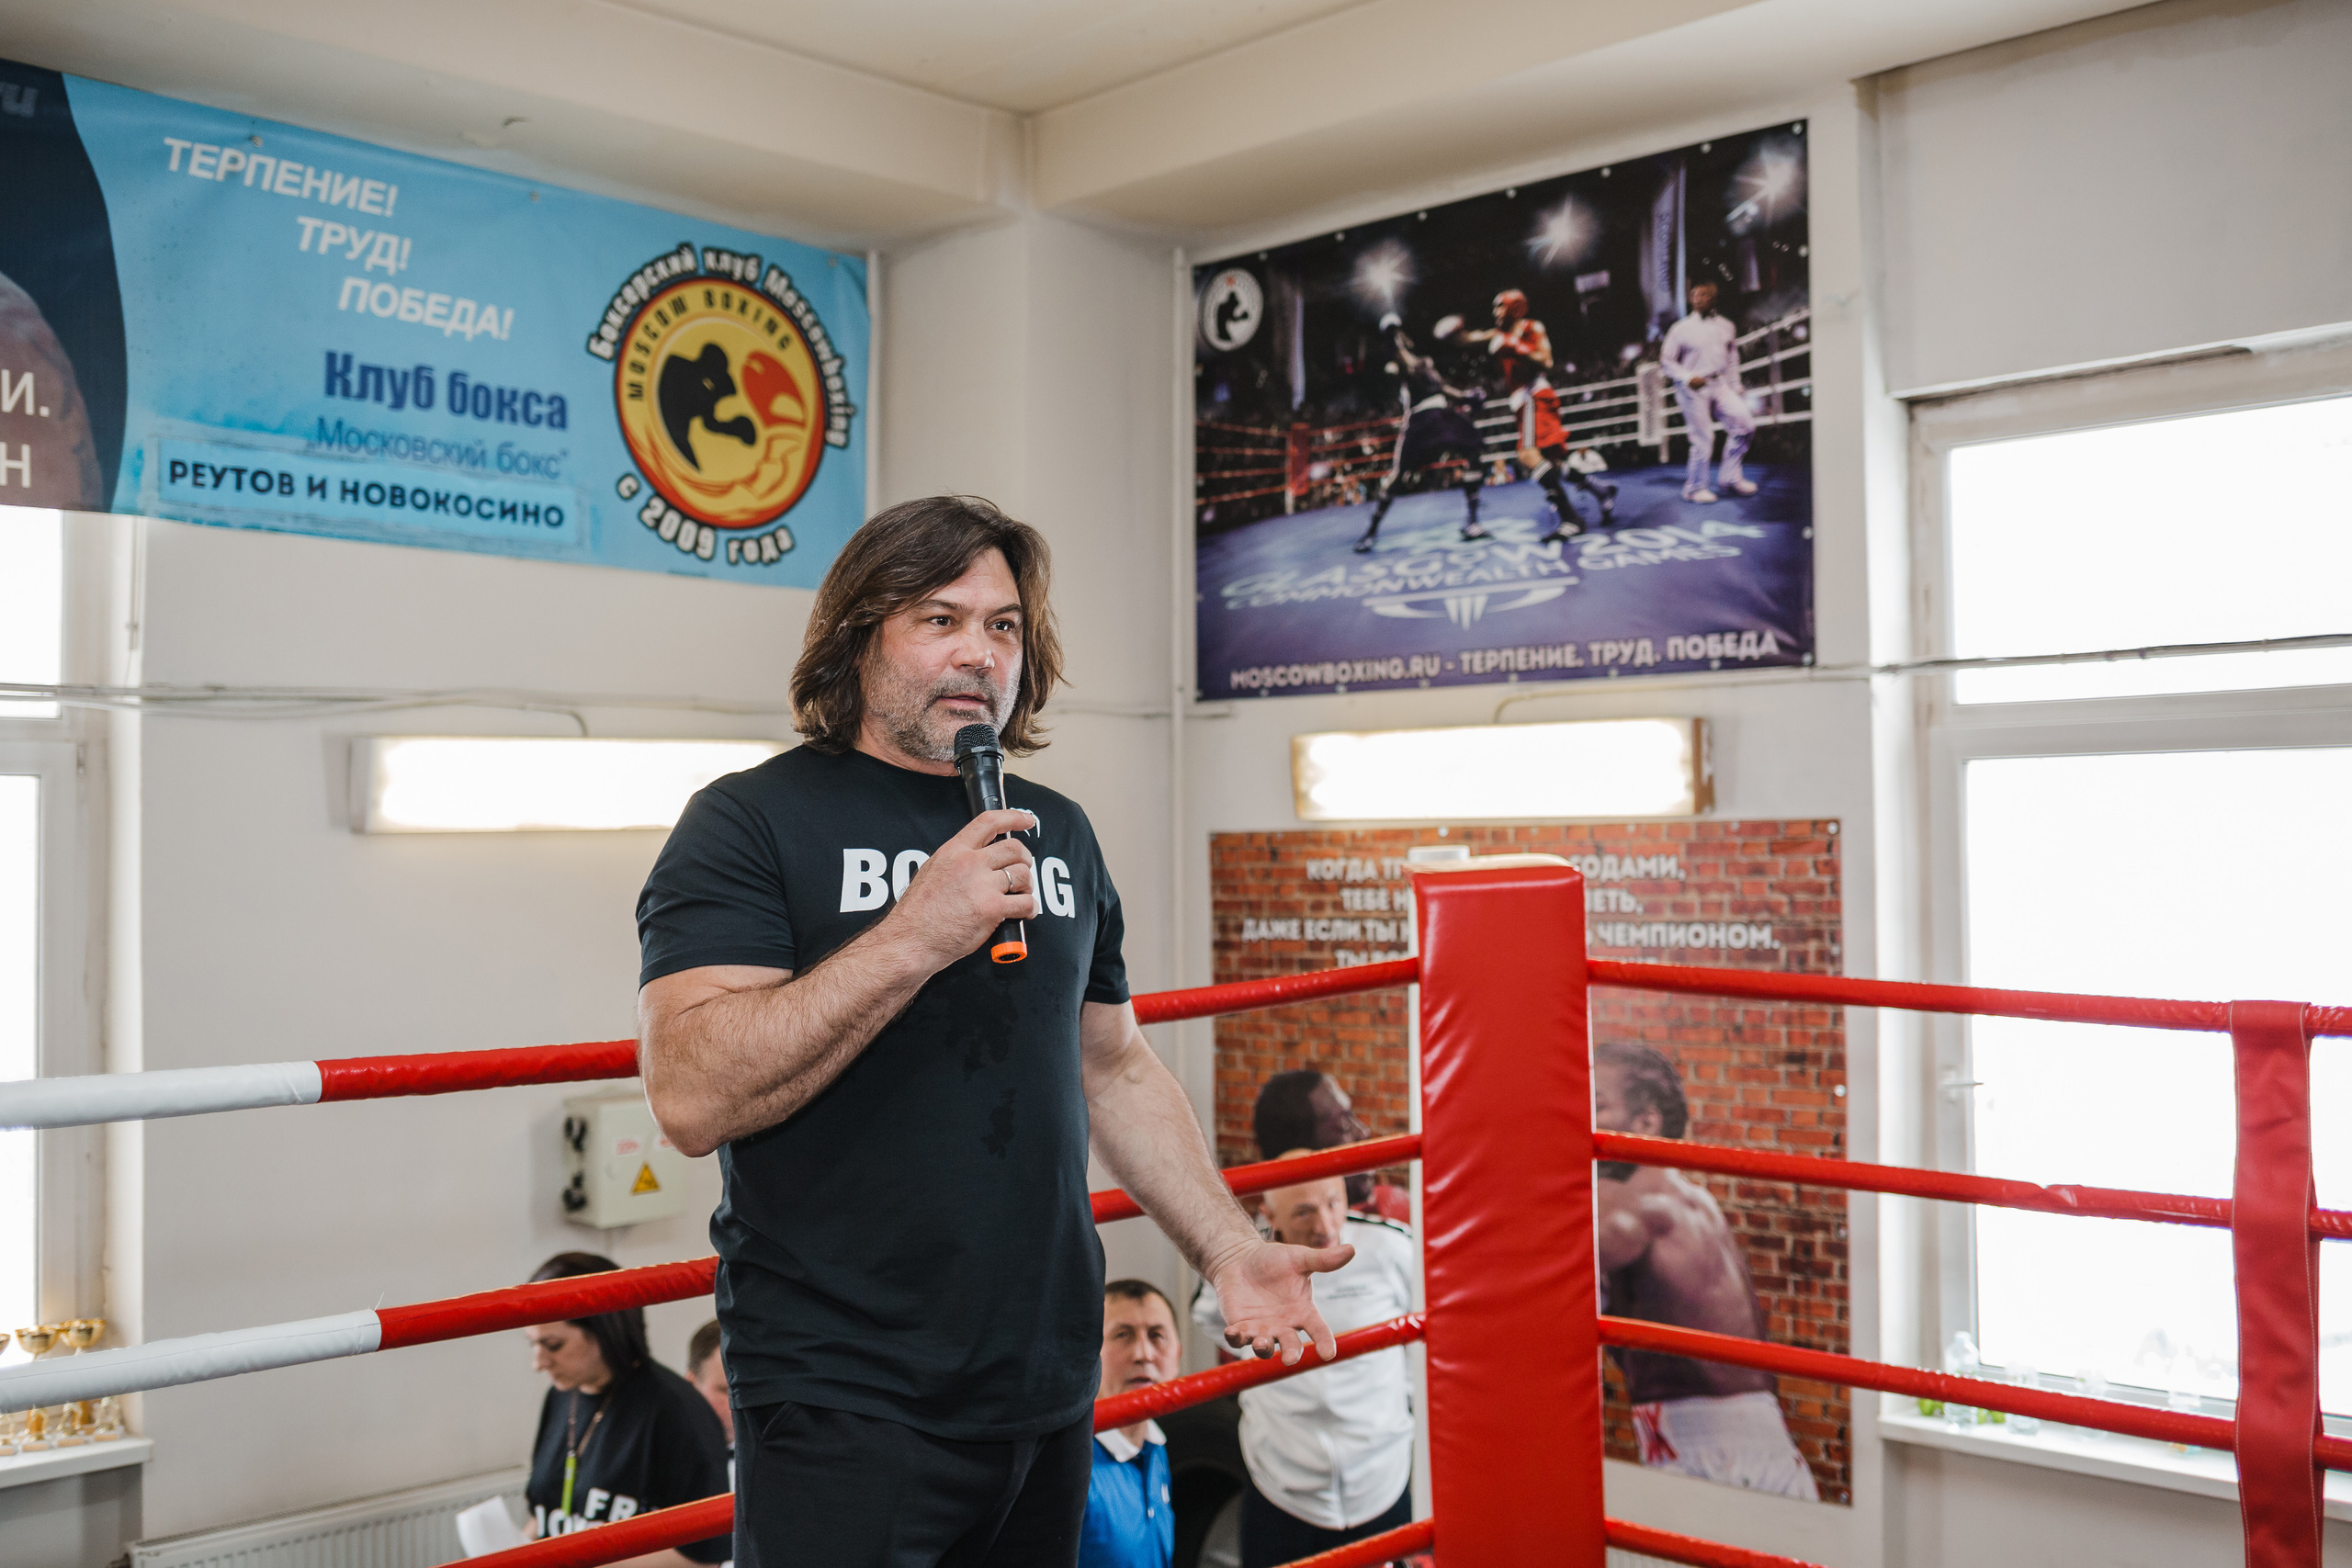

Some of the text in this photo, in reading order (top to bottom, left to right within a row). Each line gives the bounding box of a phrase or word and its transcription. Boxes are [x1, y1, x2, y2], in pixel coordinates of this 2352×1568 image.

[164, 137, 398, 217] ТЕРПЕНИЕ!
[297, 216, 411, 276] ТРУД!
[338, 276, 514, 342] ПОБЕДА!
[586, 243, 698, 361] Боксерский
[701, 247, 762, 282] клуб
[628, 288, 792, 401] MOSCOW BOXING
[324, 350, 569, 431] Клуб бокса
[169, 460, 564, 528] РЕУТОВ И НОВОКОСИНО
[639, 494, 718, 562] 2009
[726, 524, 794, 567] года
[1589, 637, 1662, 668] ТРУД.
[1667, 628, 1780, 661] ПОБЕДА
[1306, 857, 1377, 884] КОГДА
[1340, 887, 1390, 911] ТЕБЕ
[1242, 918, 1301, 943] ДАЖЕ
[1304, 918, 1362, 942] ЕСЛИ
[1363, 919, 1397, 943] ТЫ
